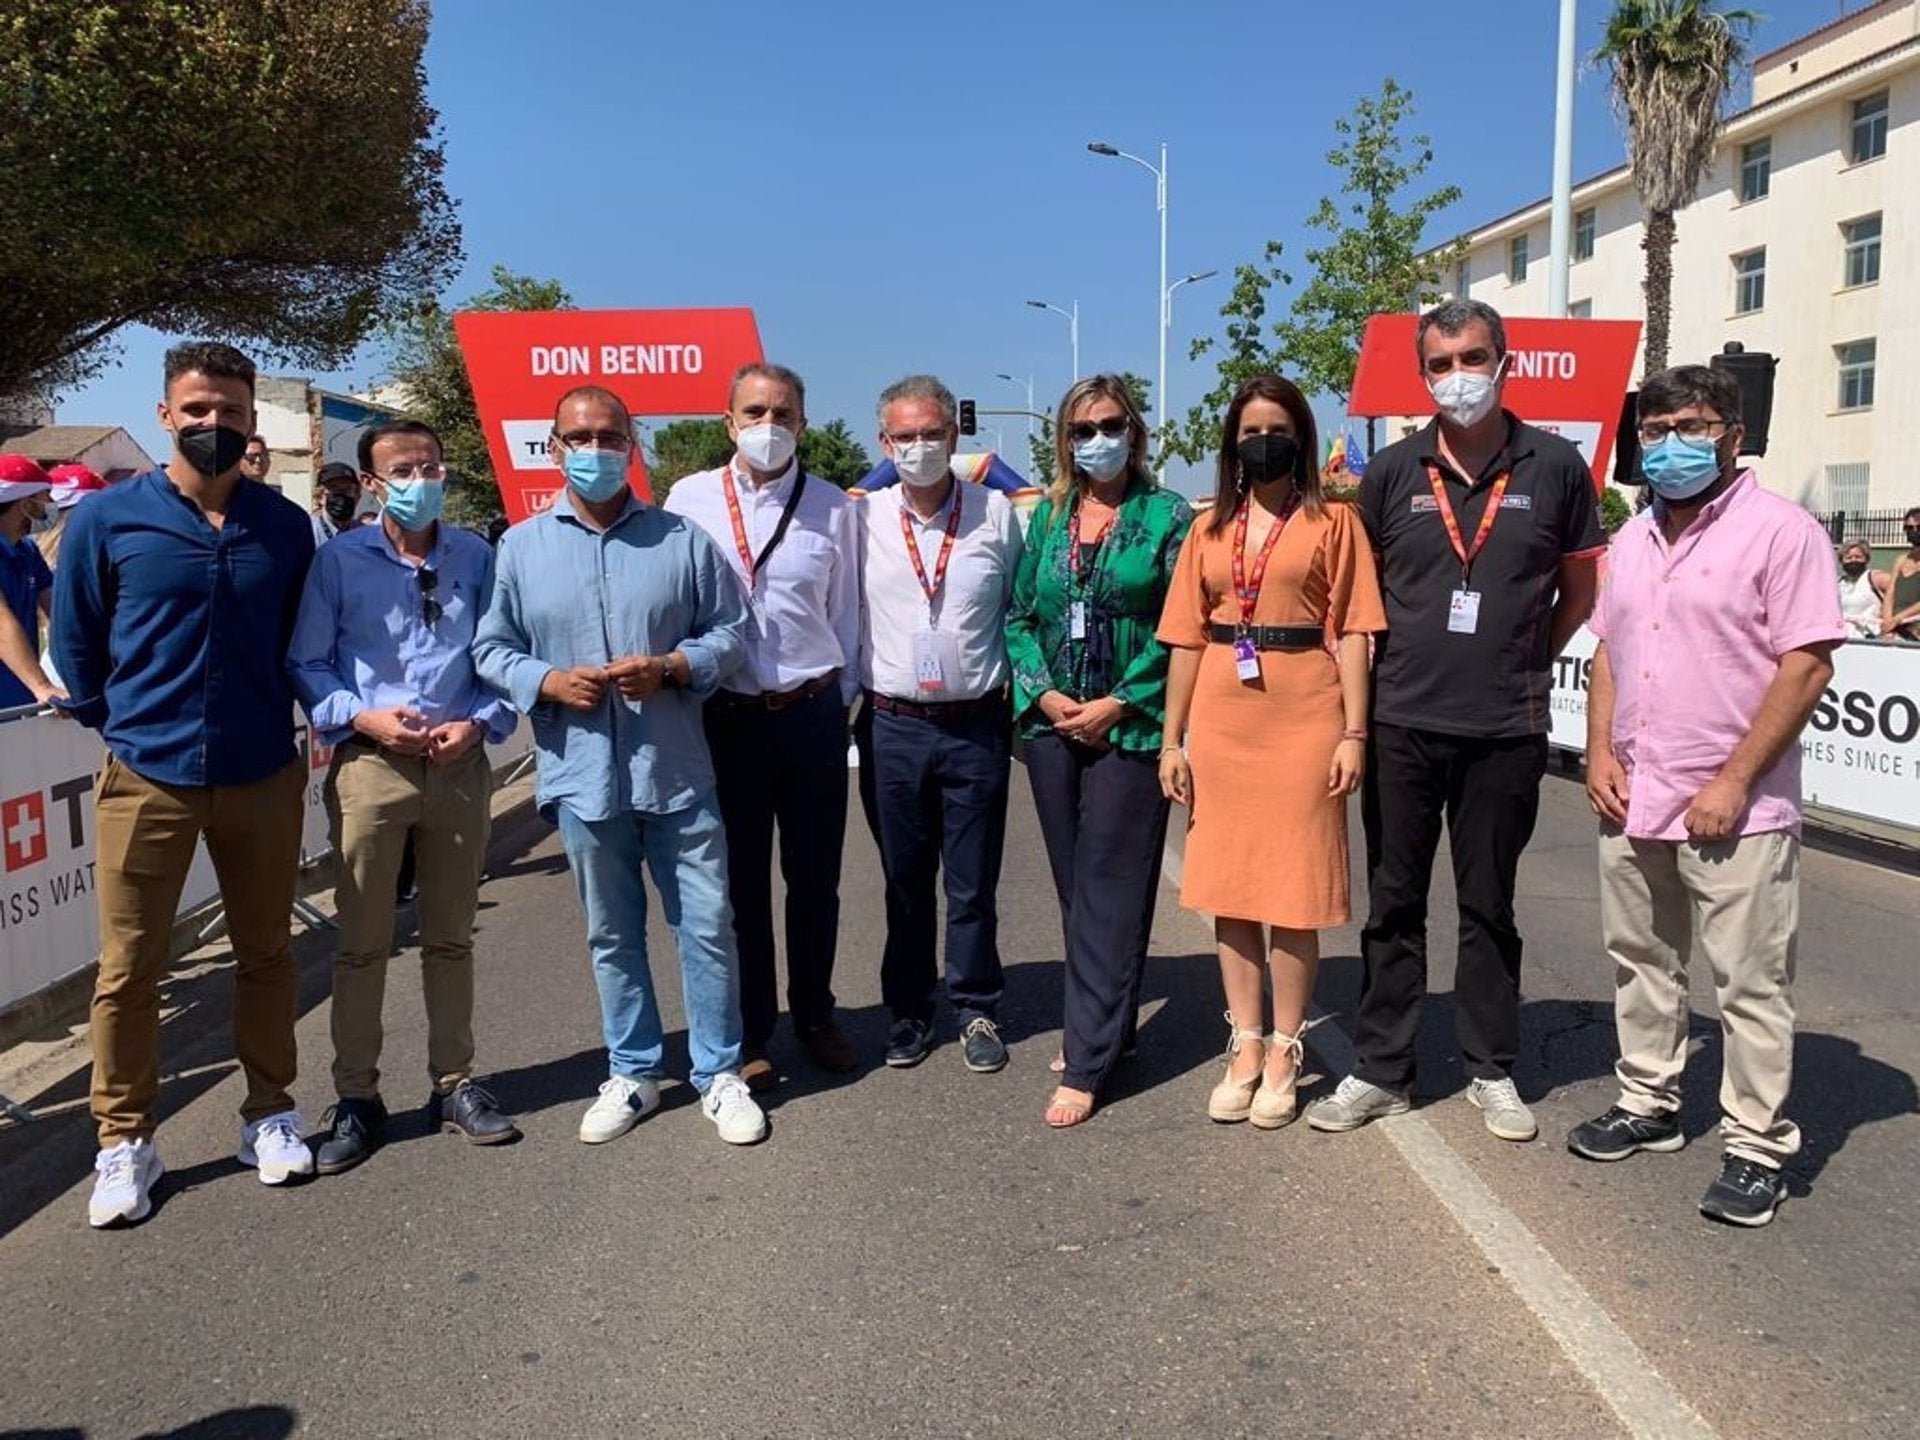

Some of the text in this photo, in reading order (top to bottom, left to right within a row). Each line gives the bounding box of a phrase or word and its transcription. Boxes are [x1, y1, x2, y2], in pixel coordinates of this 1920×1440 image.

[531, 344, 702, 376] DON BENITO
[1844, 747, 1902, 777] SINCE
[50, 862, 96, 906] WAT
